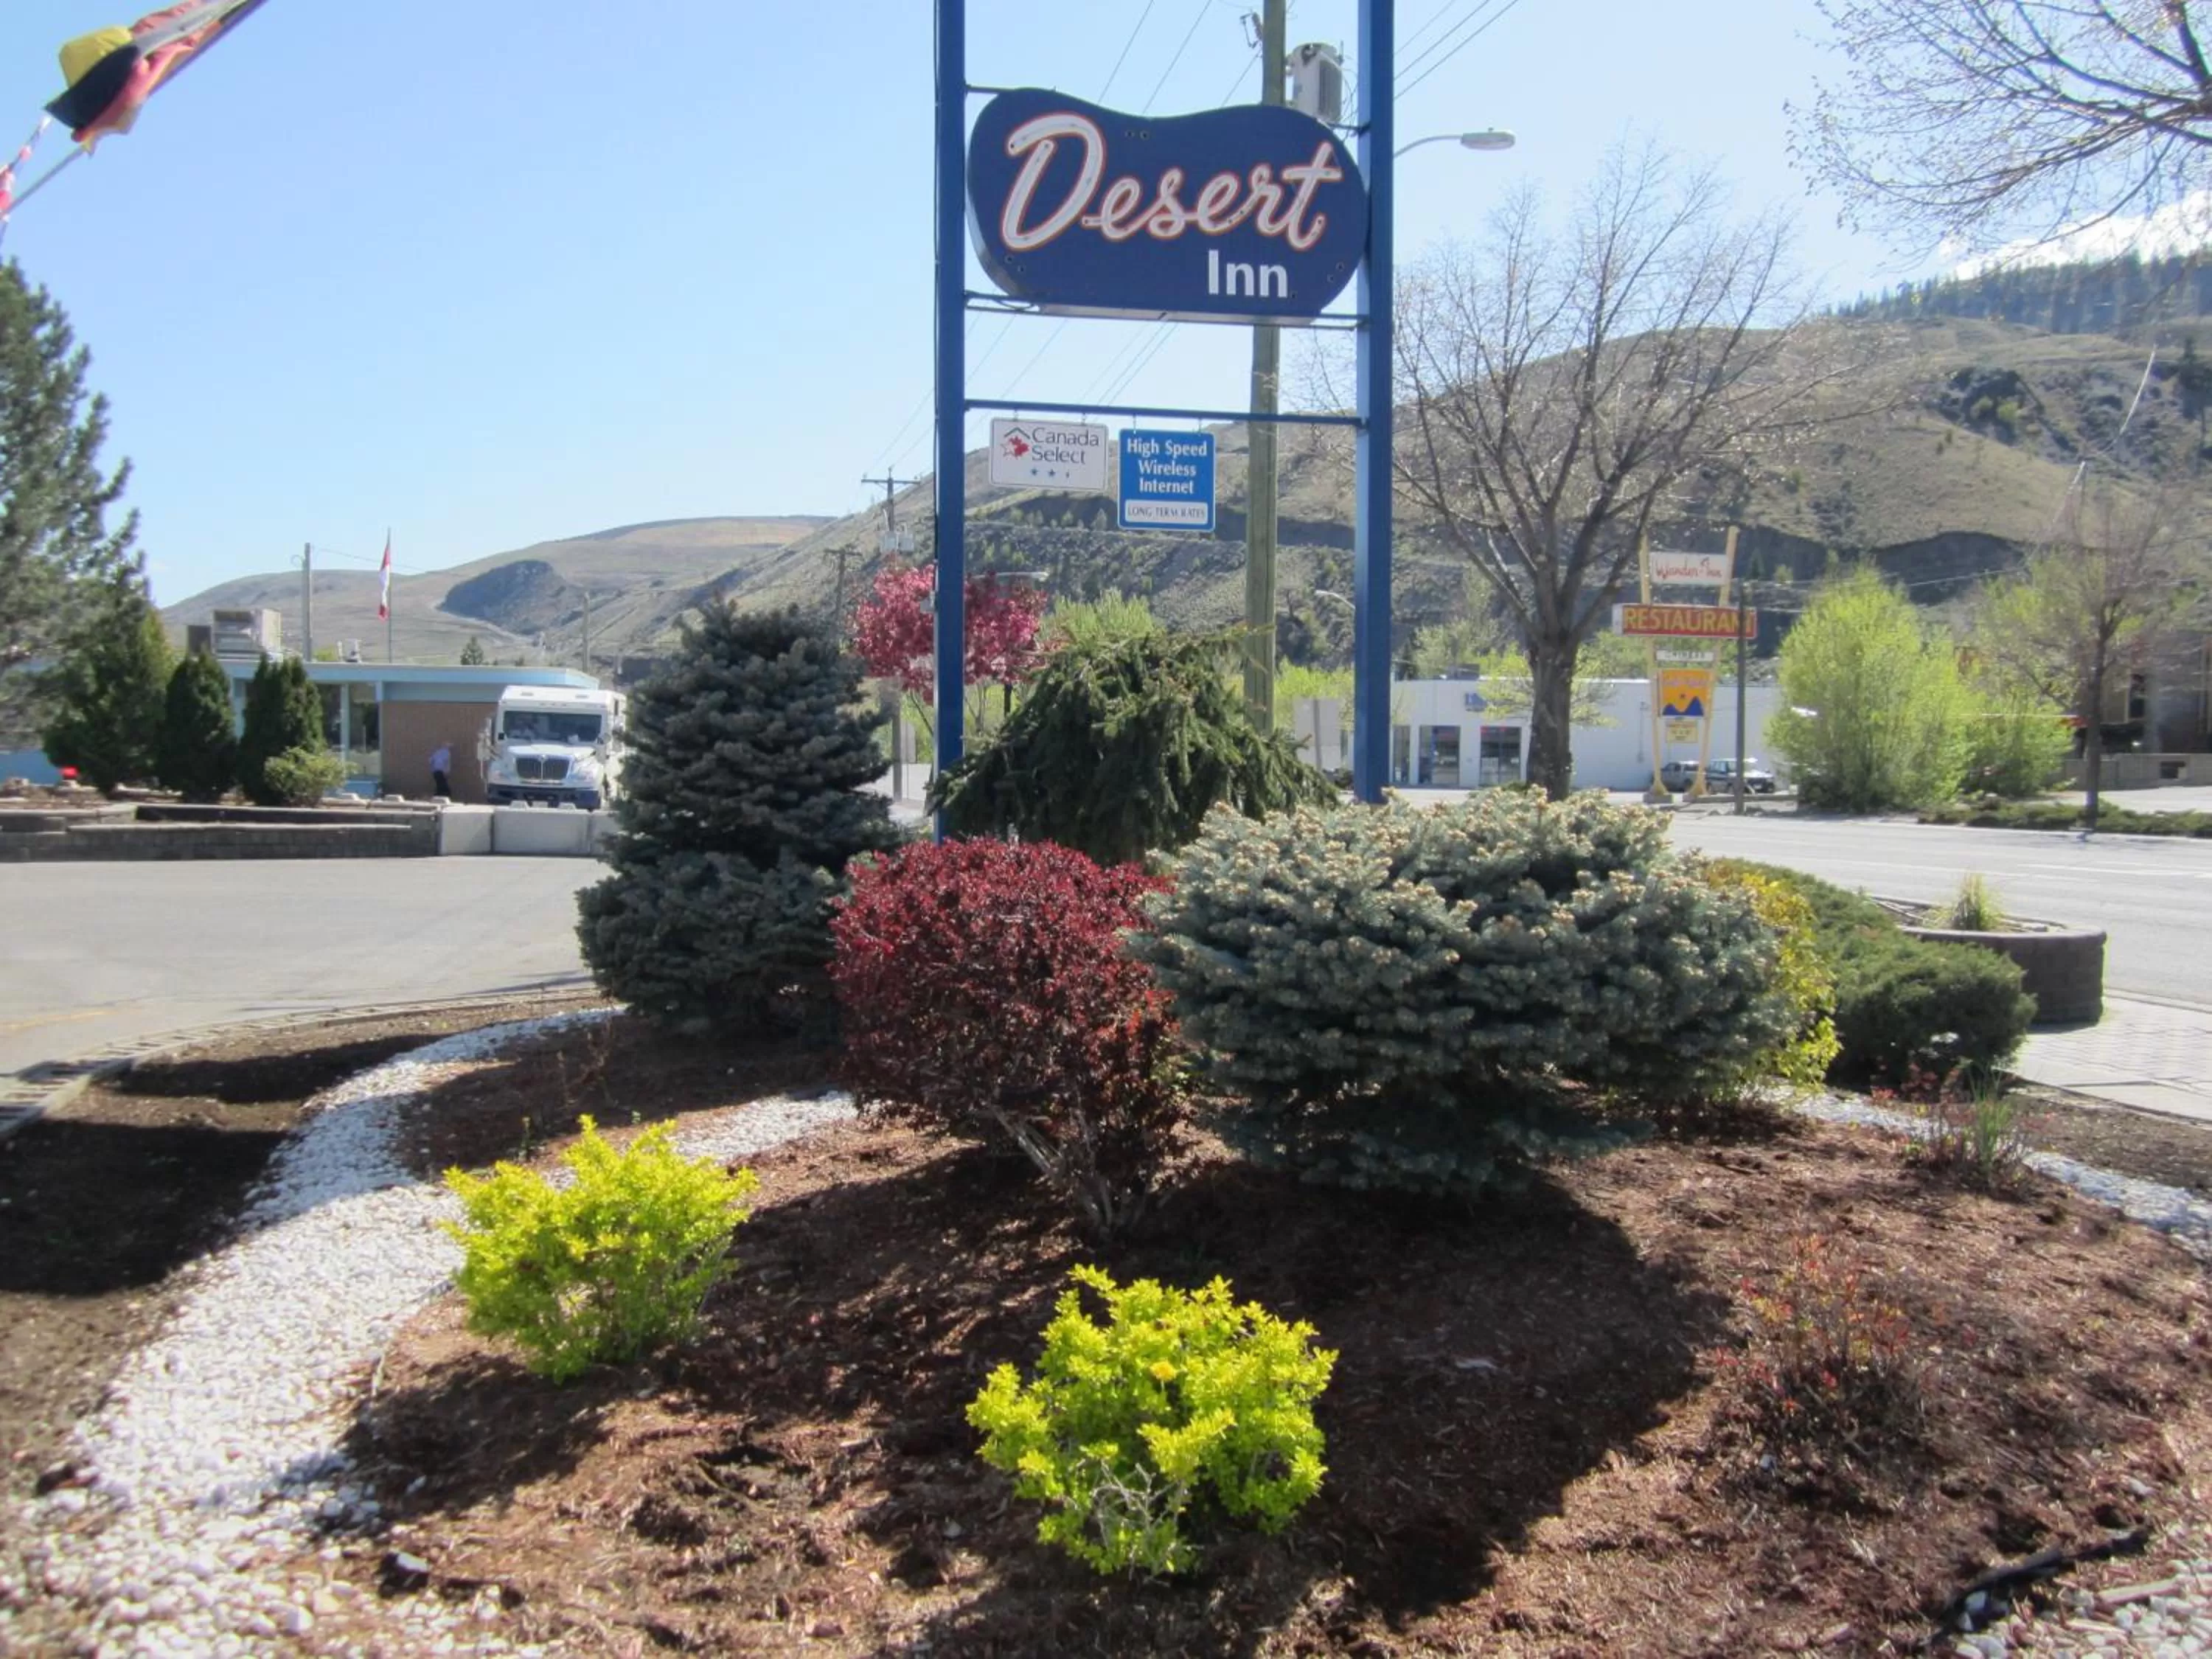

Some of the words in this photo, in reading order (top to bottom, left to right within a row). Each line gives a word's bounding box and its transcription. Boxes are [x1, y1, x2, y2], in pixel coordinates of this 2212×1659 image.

[1001, 113, 1342, 249] Desert
[1207, 249, 1288, 299] Inn
[1032, 427, 1099, 447] Canada
[1032, 446, 1086, 465] Select
[1127, 438, 1160, 458] High
[1165, 439, 1207, 458] Speed
[1138, 459, 1197, 477] Wireless
[1139, 478, 1194, 495] Internet
[1127, 506, 1152, 517] LONG
